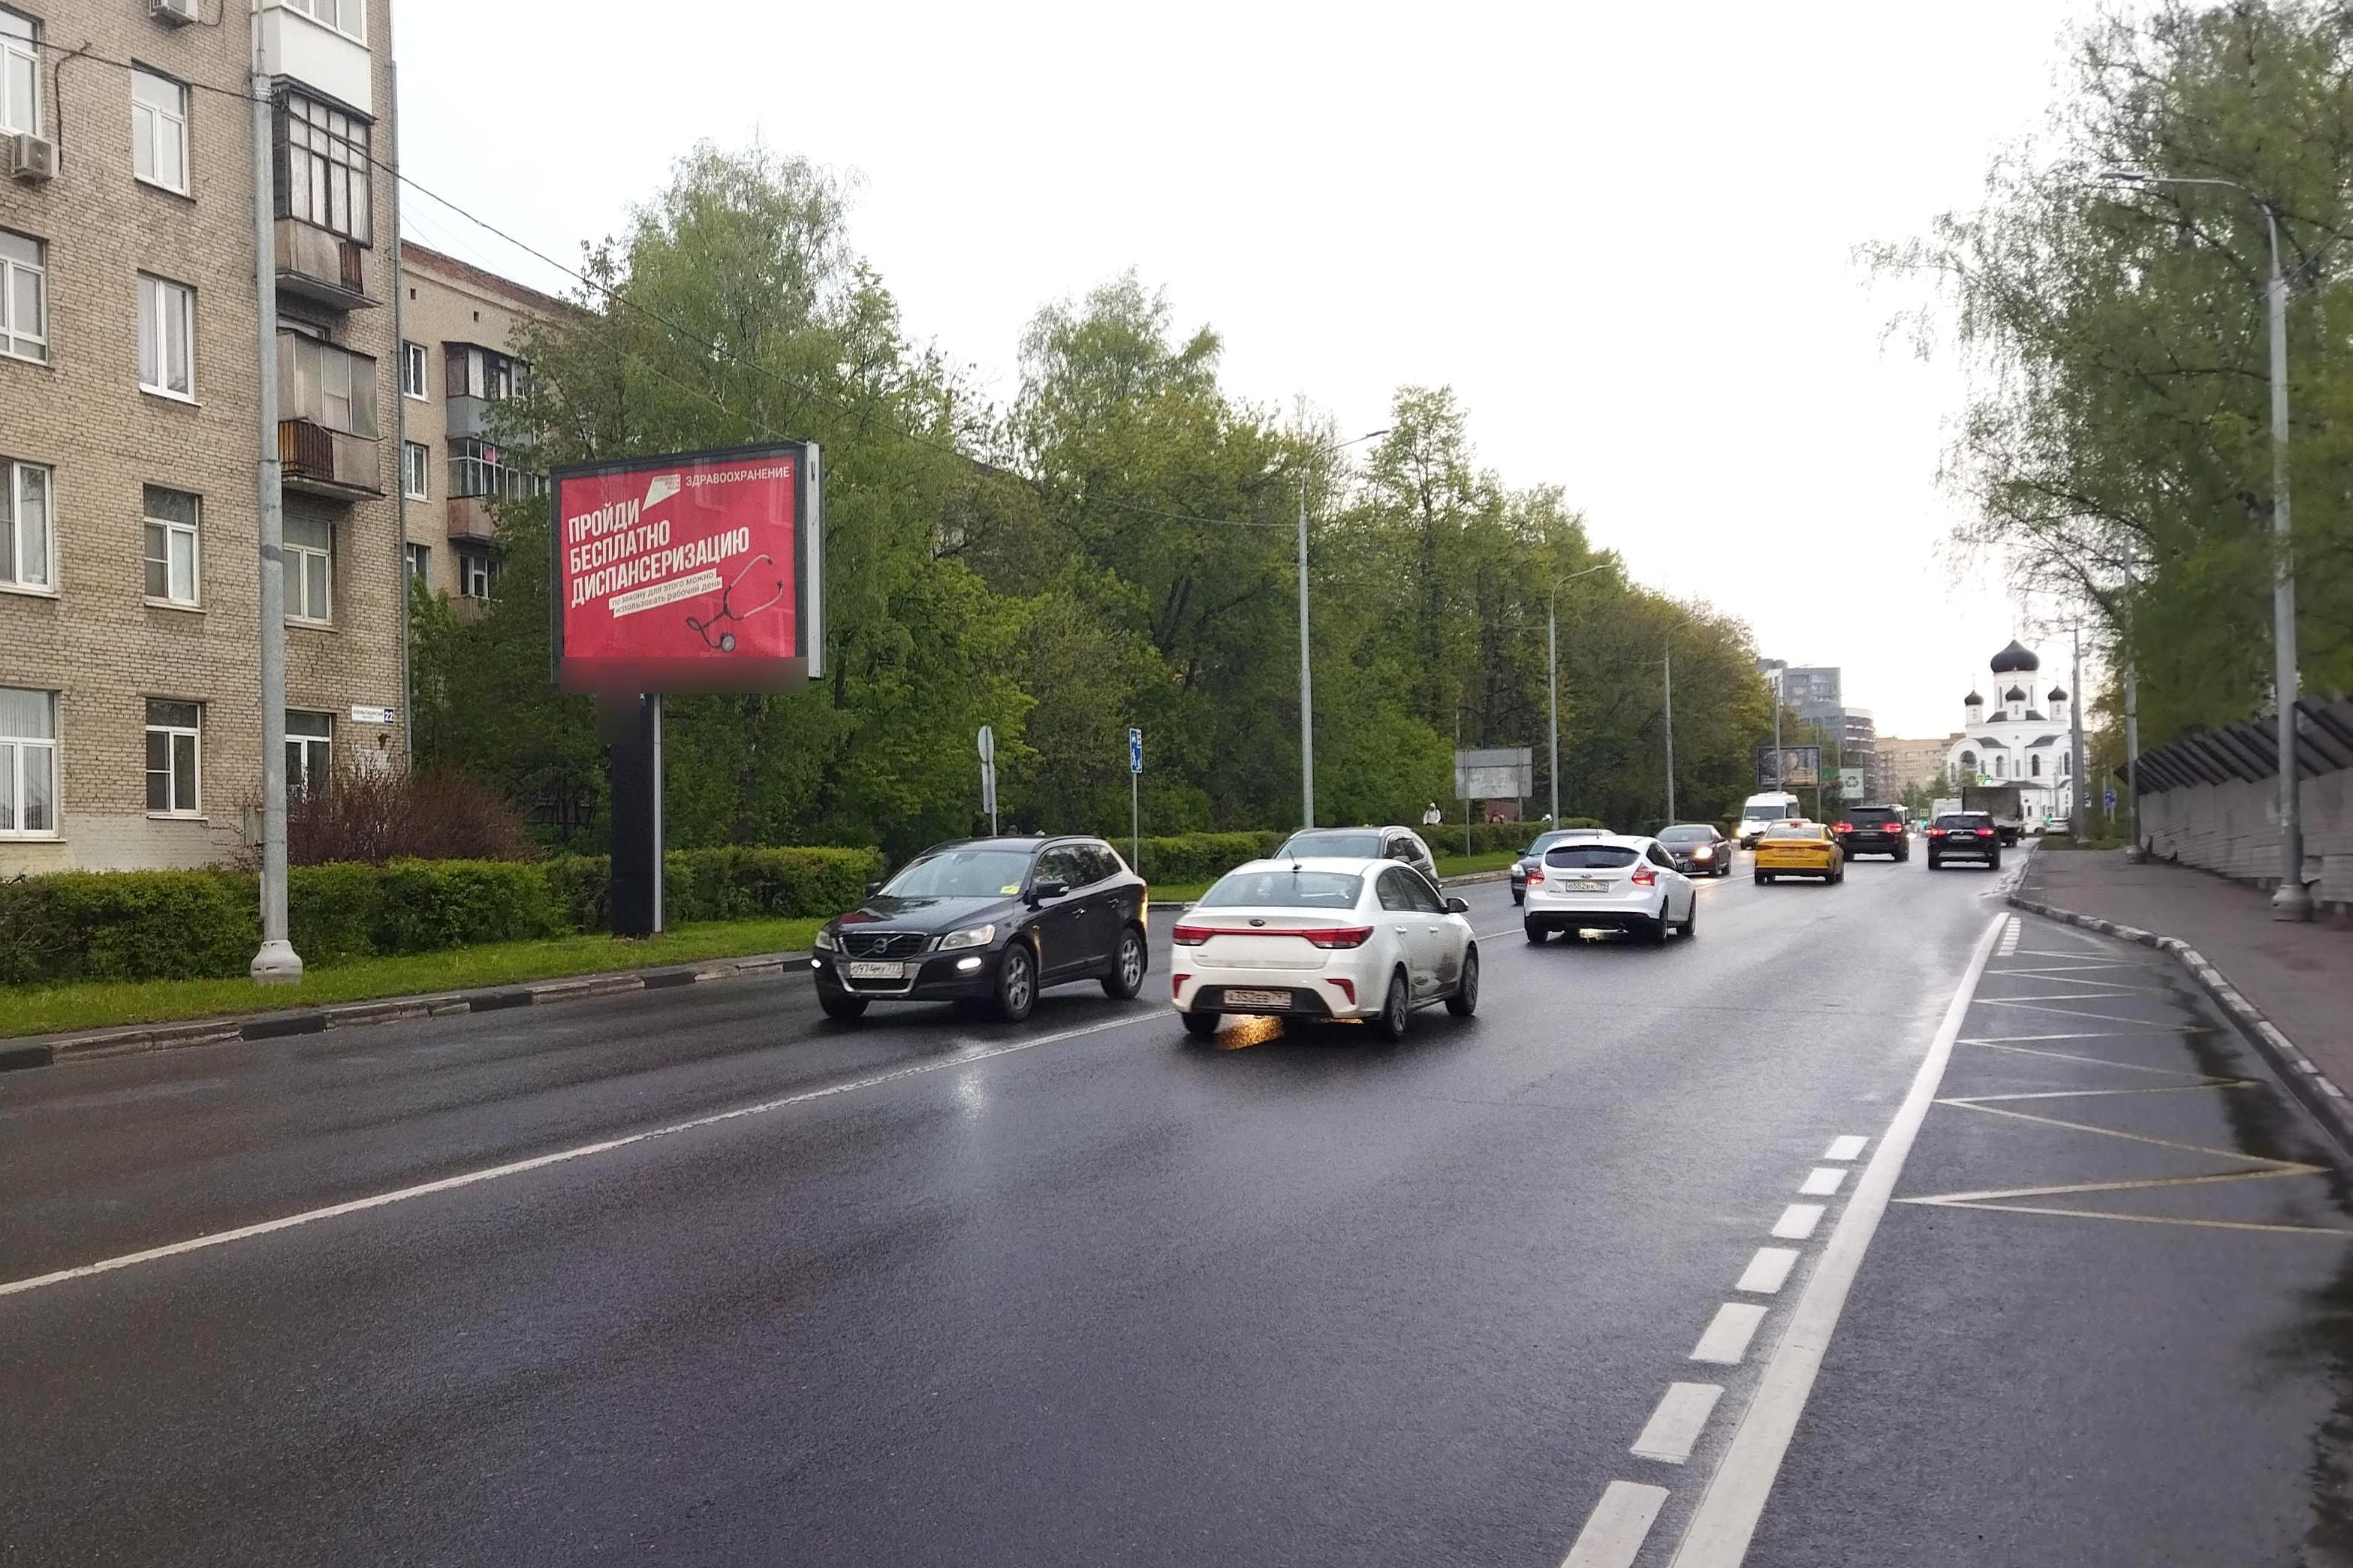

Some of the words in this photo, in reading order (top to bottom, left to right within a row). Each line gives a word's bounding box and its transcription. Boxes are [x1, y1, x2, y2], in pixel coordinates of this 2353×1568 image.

[685, 466, 790, 487] ЗДРАВООХРАНЕНИЕ
[568, 498, 639, 544] ПРОЙДИ
[570, 519, 670, 575] БЕСПЛАТНО
[571, 527, 749, 608] ДИСПАНСЕРИЗАЦИЮ
[616, 596, 667, 614] использовать
[667, 586, 700, 603] рабочий
[701, 580, 721, 592] день
[622, 591, 646, 605] закону
[648, 587, 662, 597] для
[664, 581, 684, 592] этого
[686, 572, 714, 585] можно
[384, 711, 393, 721] 22
